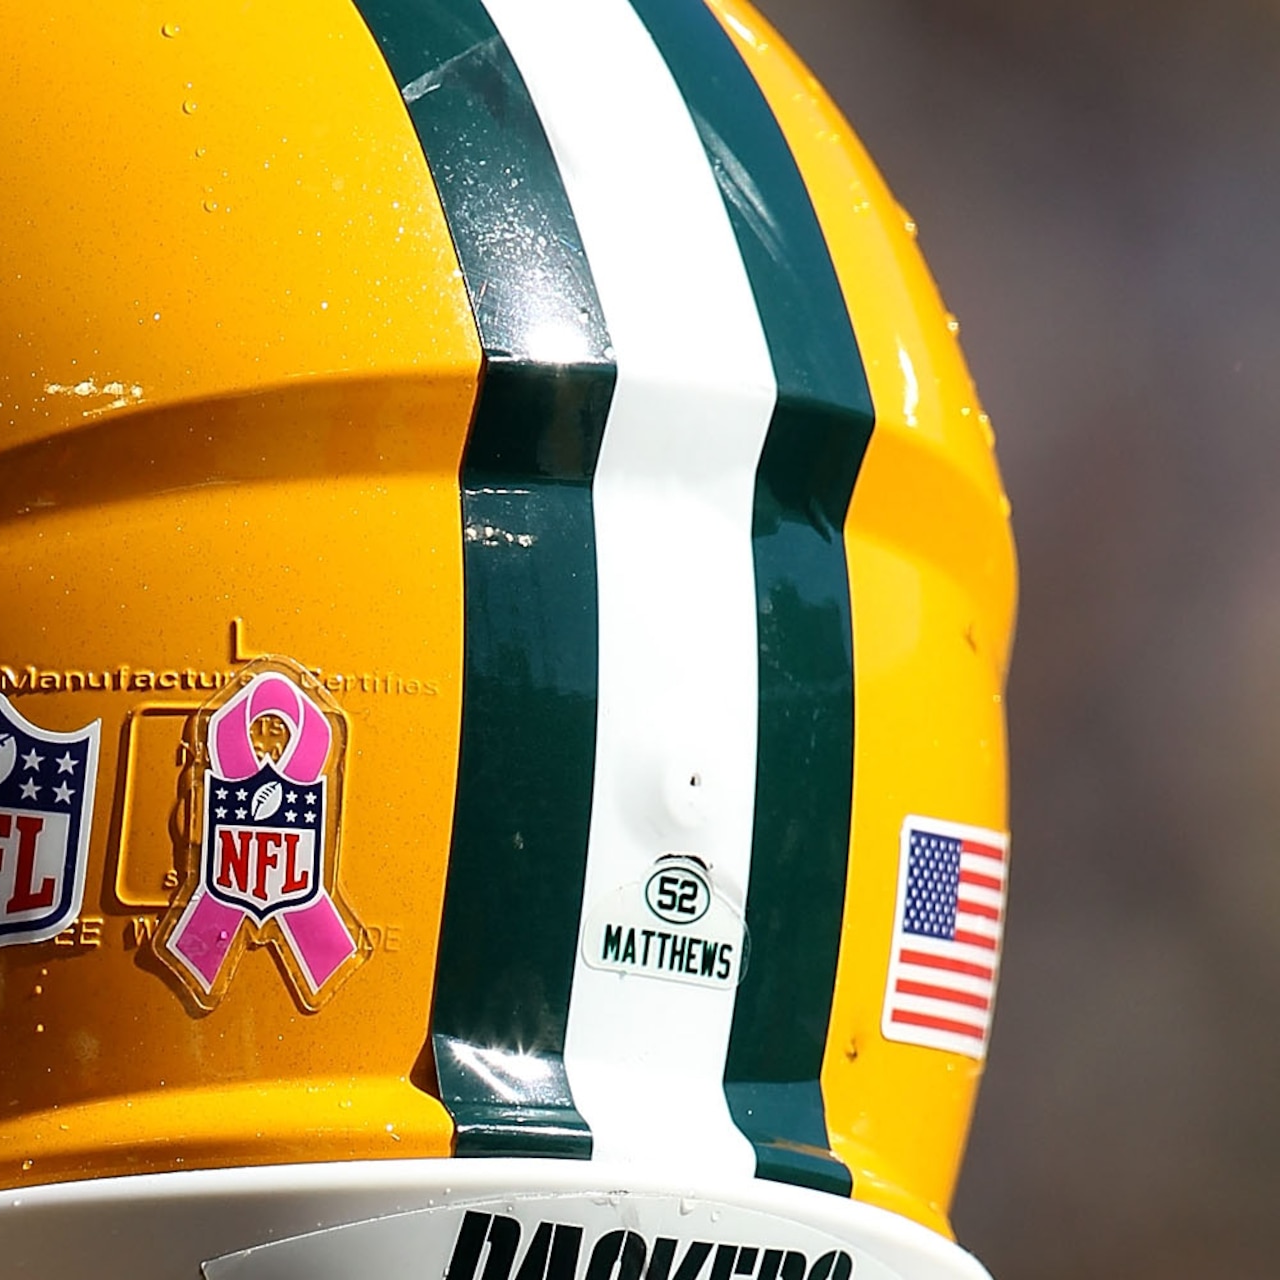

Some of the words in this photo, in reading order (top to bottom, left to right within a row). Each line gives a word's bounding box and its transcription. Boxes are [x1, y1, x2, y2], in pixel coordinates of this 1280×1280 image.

[217, 830, 309, 900] NFL
[656, 876, 698, 915] 52
[602, 924, 733, 980] MATTHEWS
